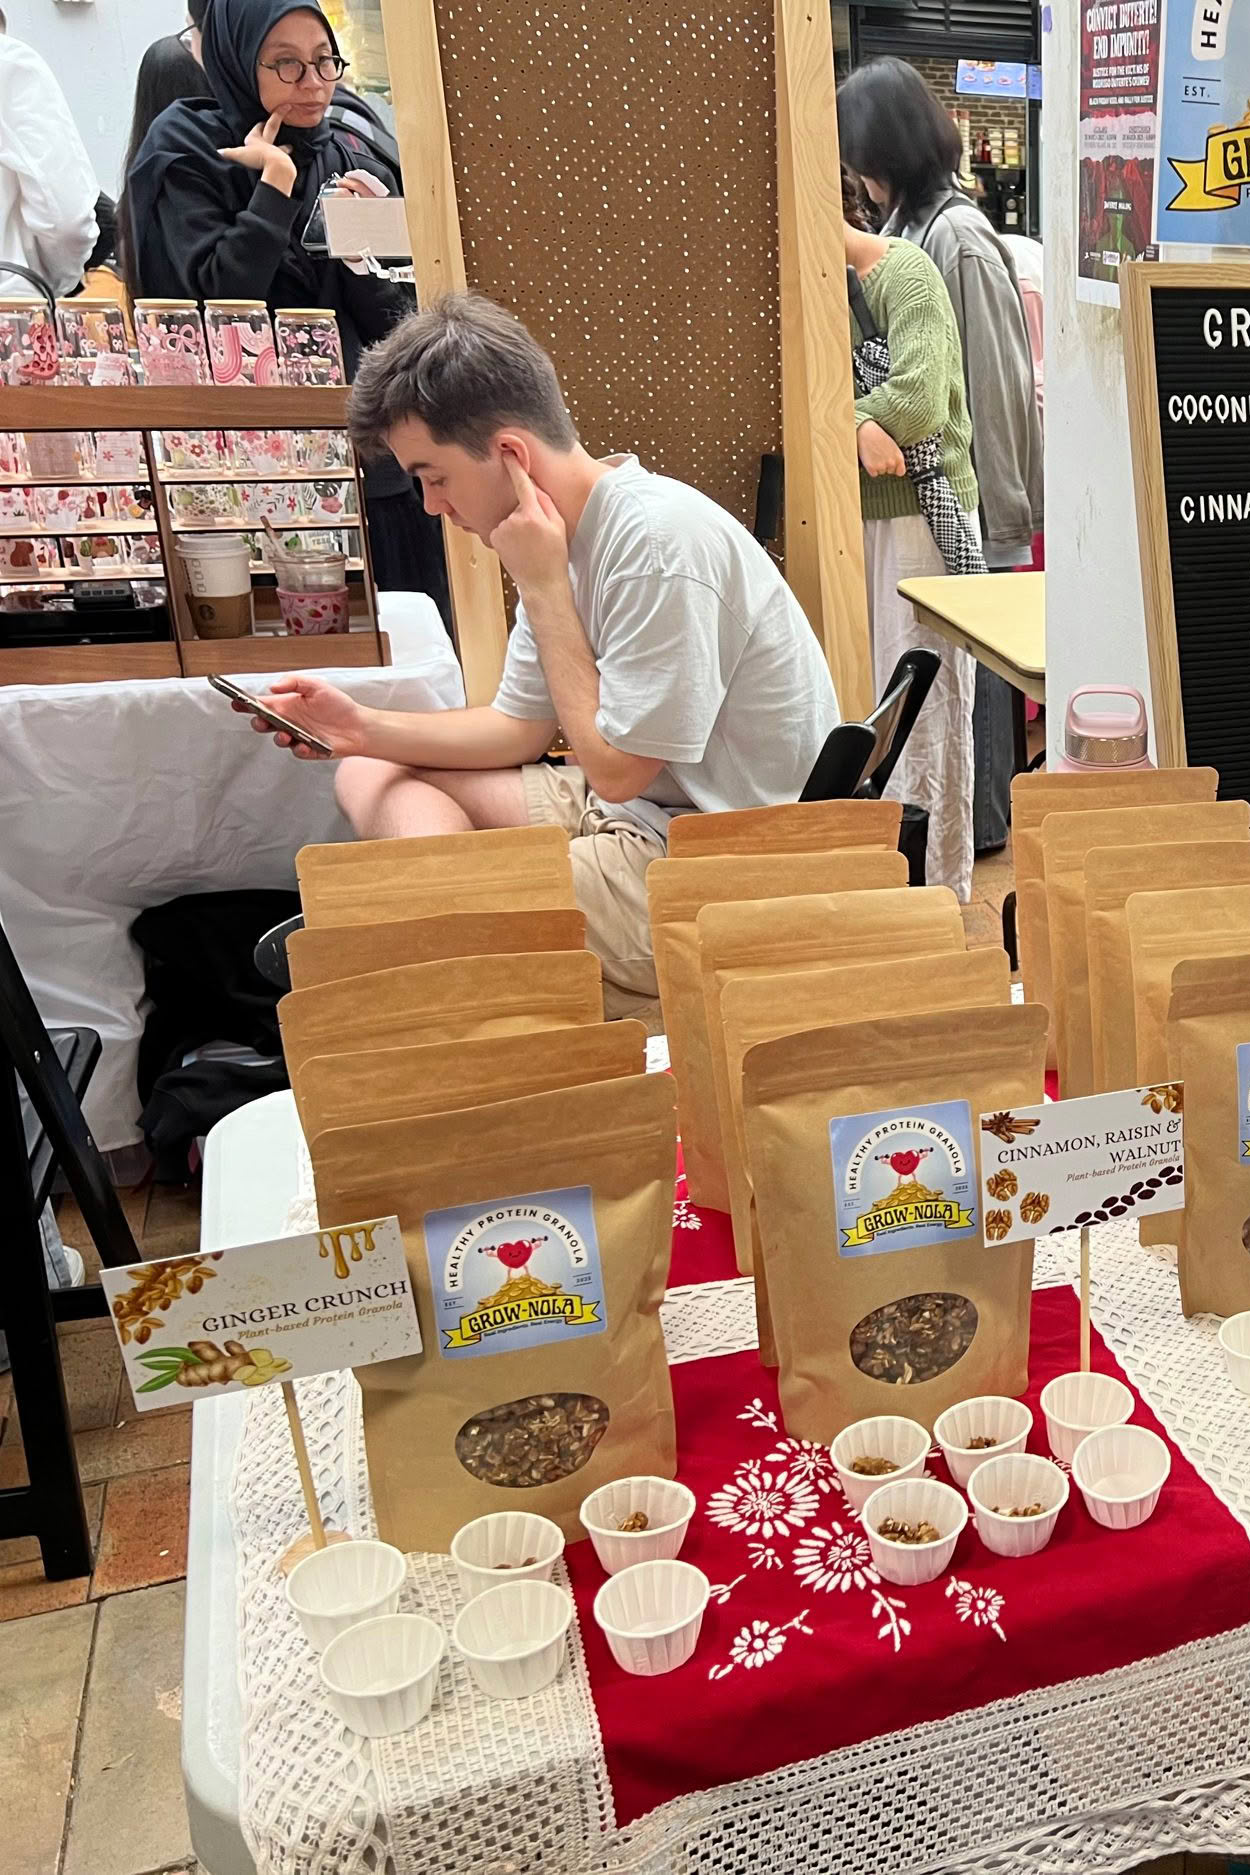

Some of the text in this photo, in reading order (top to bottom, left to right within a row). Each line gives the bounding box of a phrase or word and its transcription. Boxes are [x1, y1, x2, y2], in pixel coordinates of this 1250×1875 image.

[1087, 4, 1117, 32] CONVICT
[1093, 35, 1108, 60] END
[1184, 85, 1210, 98] EST.
[850, 1121, 962, 1190] HEALTHY PROTEIN GRANOLA
[997, 1118, 1182, 1164] CINNAMON, RAISIN &
[1109, 1140, 1181, 1164] WALNUT
[1066, 1154, 1181, 1183] Plant-based Protein Granola
[864, 1204, 953, 1232] GROW-NOLA
[449, 1208, 584, 1288] HEALTHY PROTEIN GRANOLA
[202, 1280, 409, 1332] GINGER CRUNCH
[237, 1300, 403, 1341] Plant-based Protein Granola
[468, 1298, 574, 1334] GROW-NOLA
